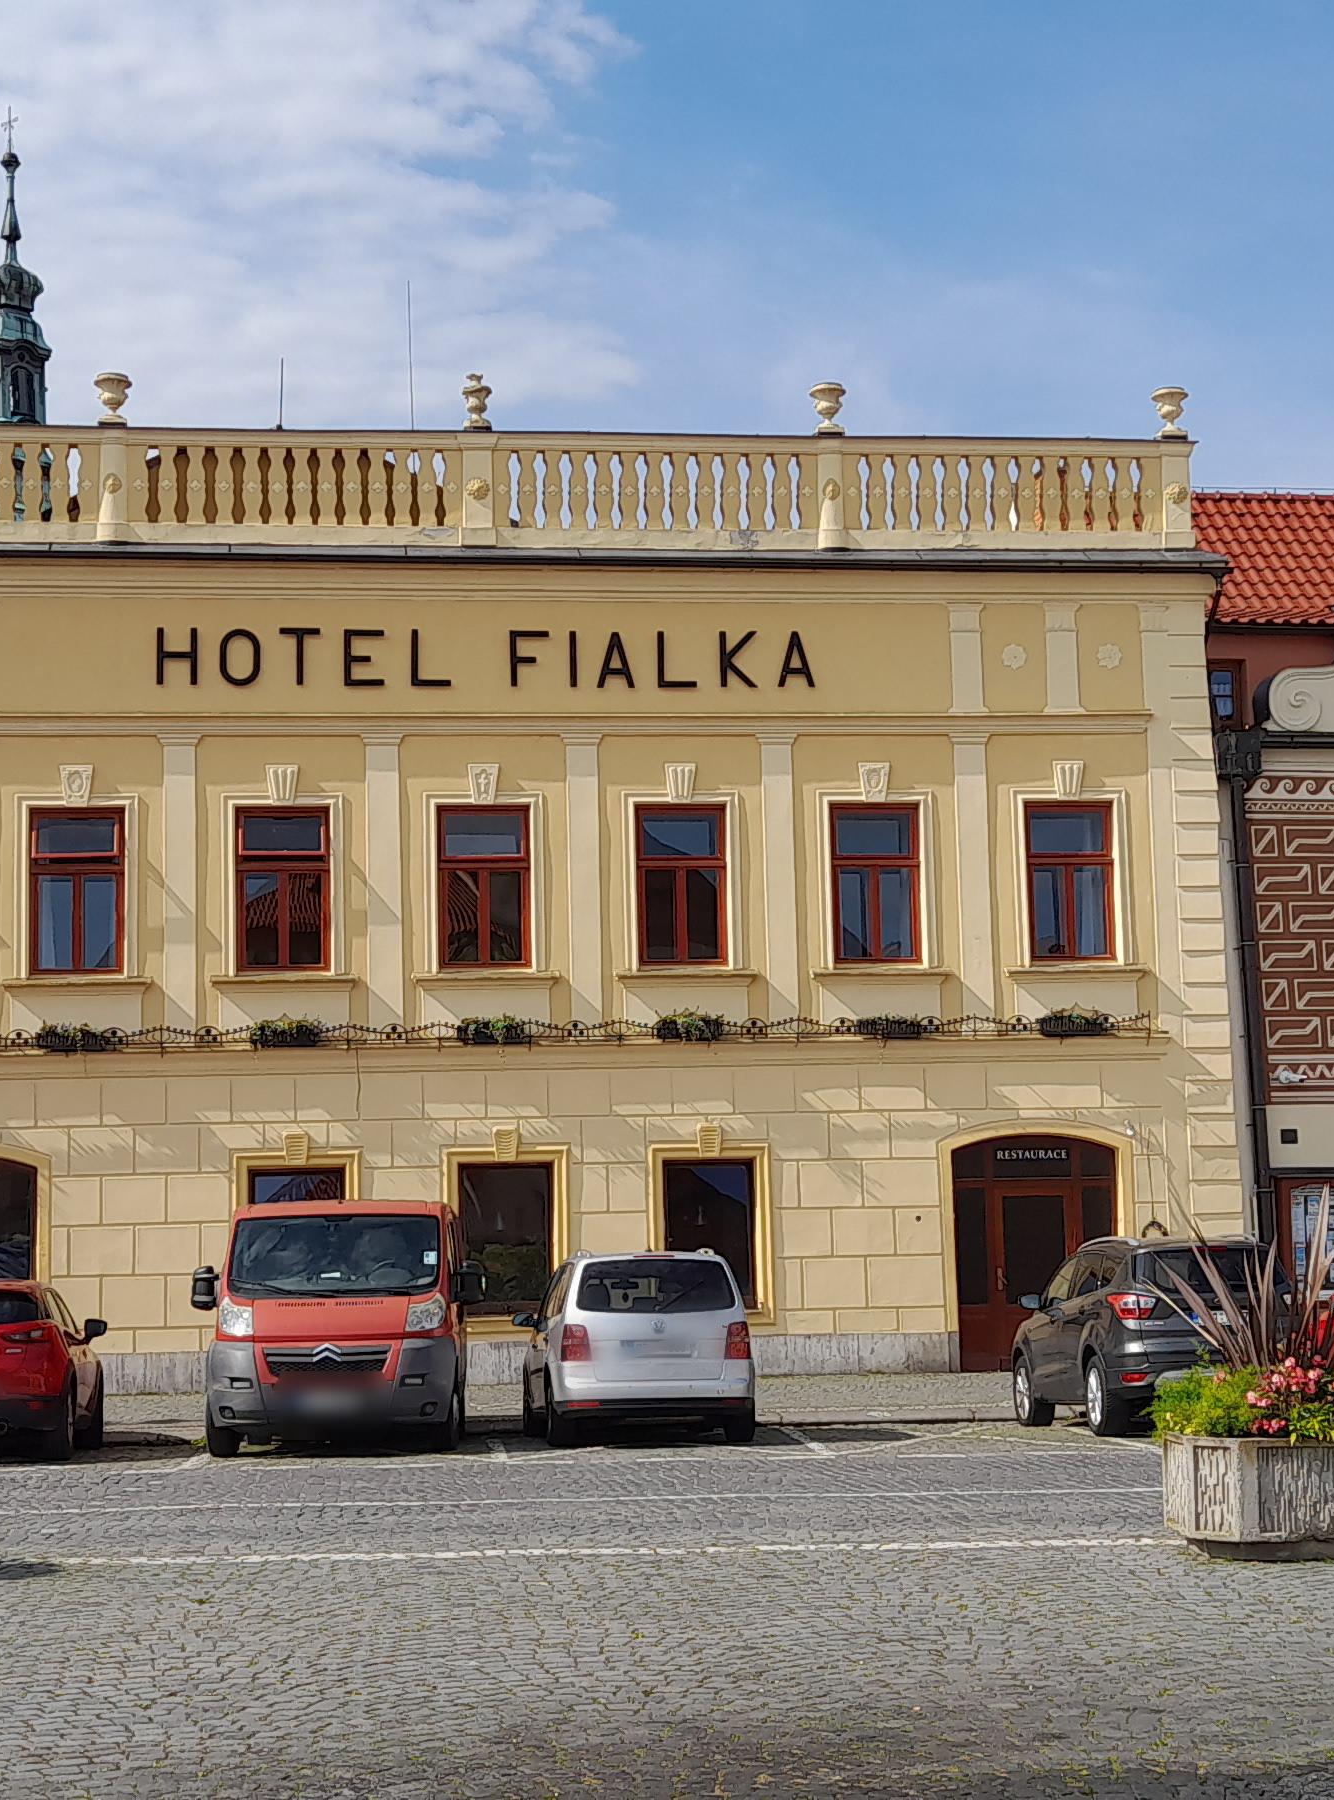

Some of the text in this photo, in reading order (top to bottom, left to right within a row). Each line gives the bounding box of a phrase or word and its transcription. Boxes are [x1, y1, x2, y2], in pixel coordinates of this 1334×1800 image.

[156, 627, 815, 689] HOTEL FIALKA
[996, 1149, 1068, 1160] RESTAURACE
